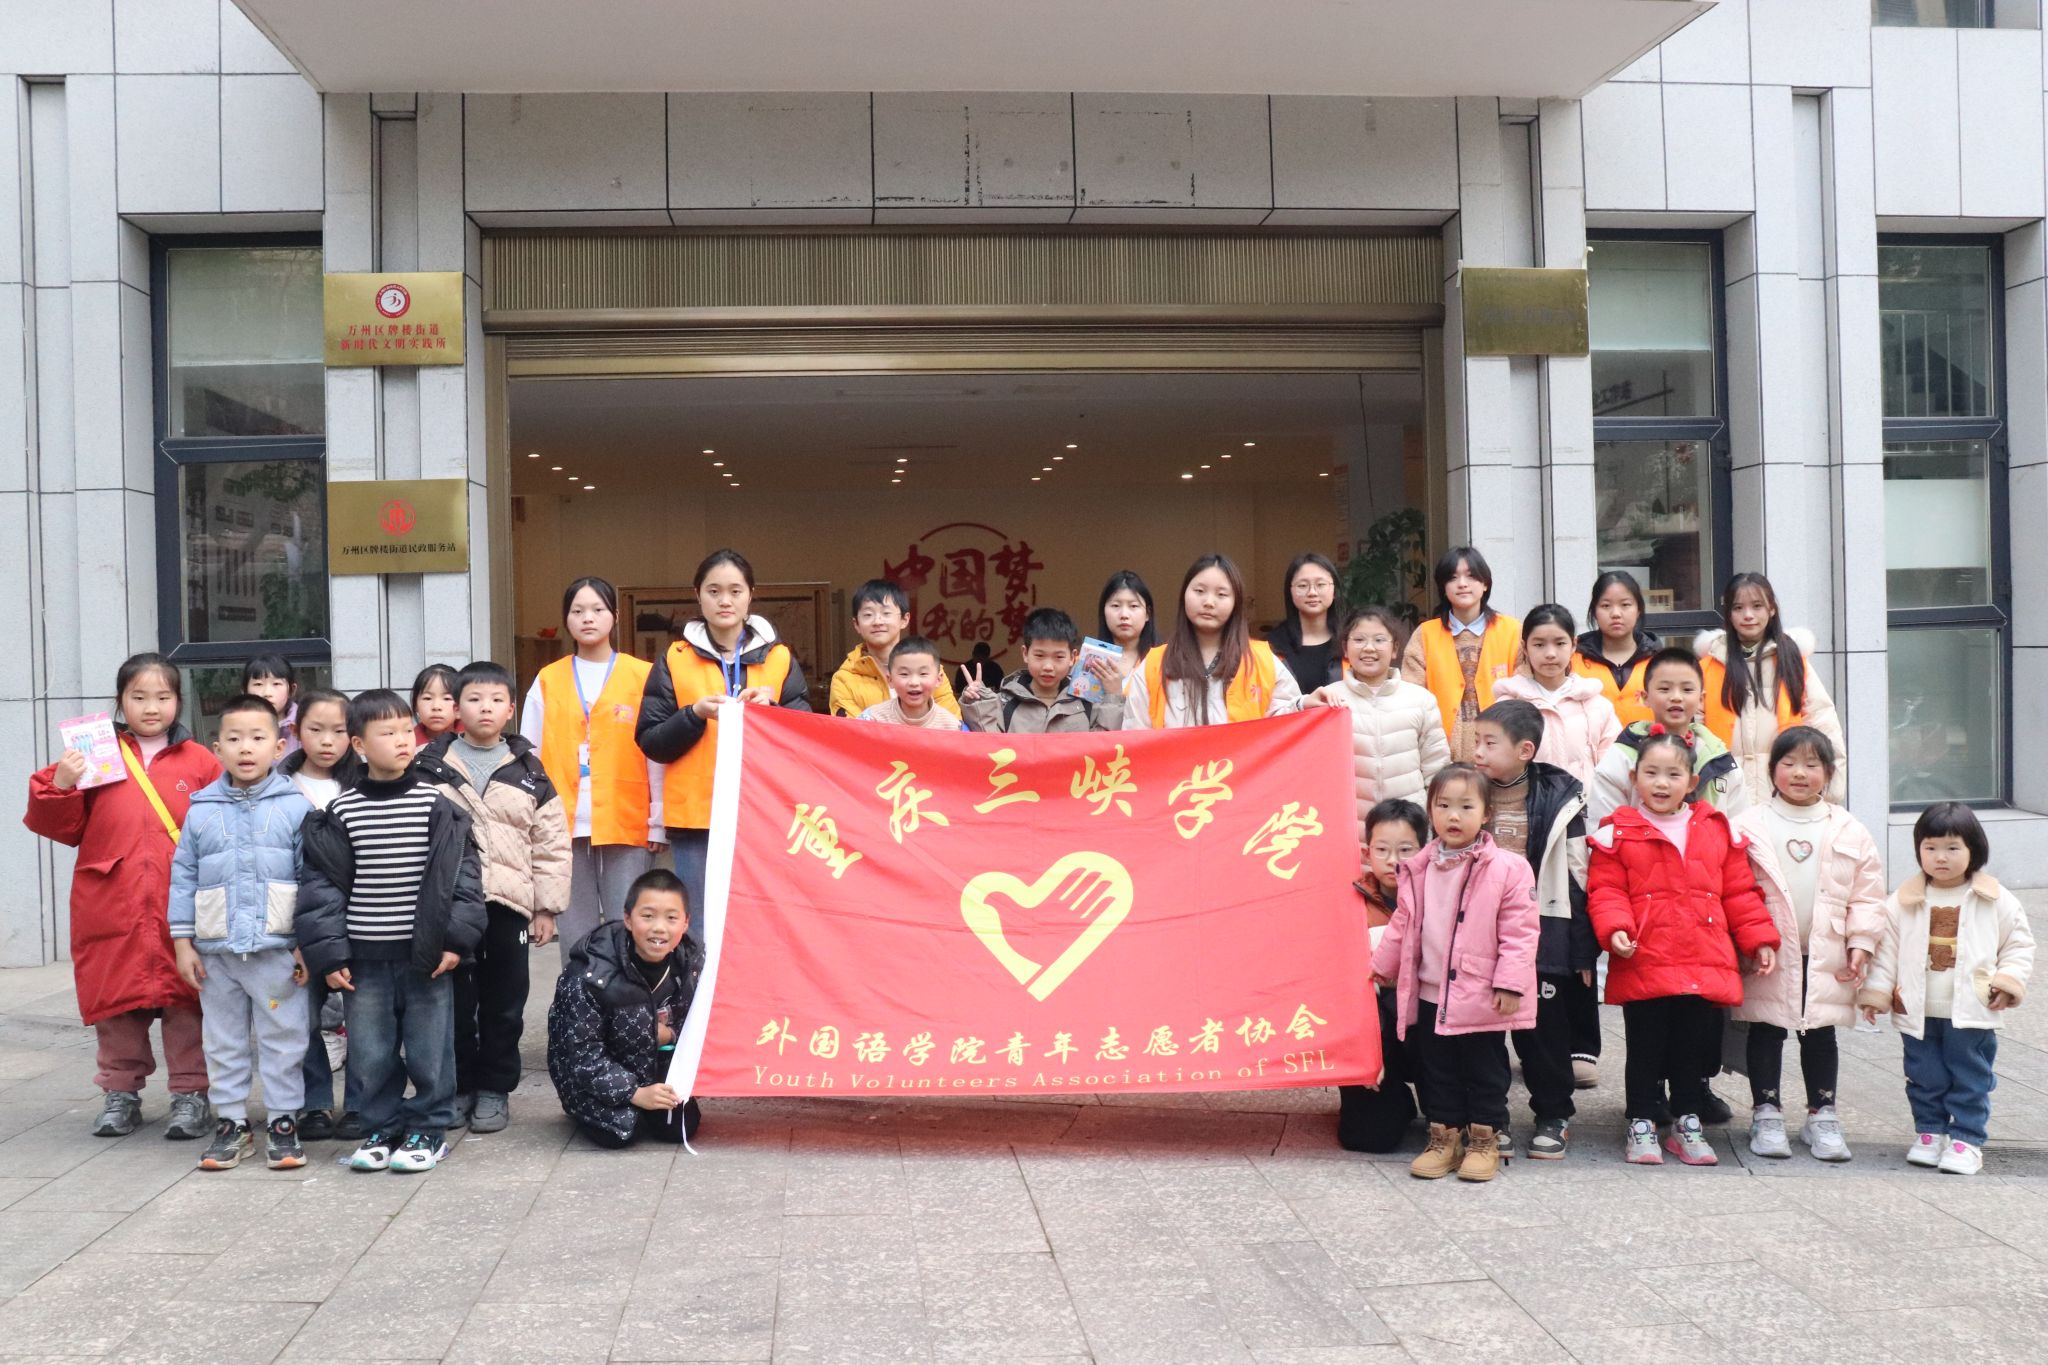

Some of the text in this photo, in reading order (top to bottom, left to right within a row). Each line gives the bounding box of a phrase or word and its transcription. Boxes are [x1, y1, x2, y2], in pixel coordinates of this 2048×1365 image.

[340, 337, 446, 350] 新时代文明实践所
[348, 323, 439, 336] 万州区牌楼街道
[342, 542, 456, 555] 万州区牌楼街道民政服务站
[884, 541, 1044, 635] 中国梦
[787, 744, 1323, 879] 重庆三峡学院
[756, 1003, 1328, 1066] 外国语学院青年志愿者协会
[753, 1048, 1335, 1089] Youth Volunteers Association of SFL
